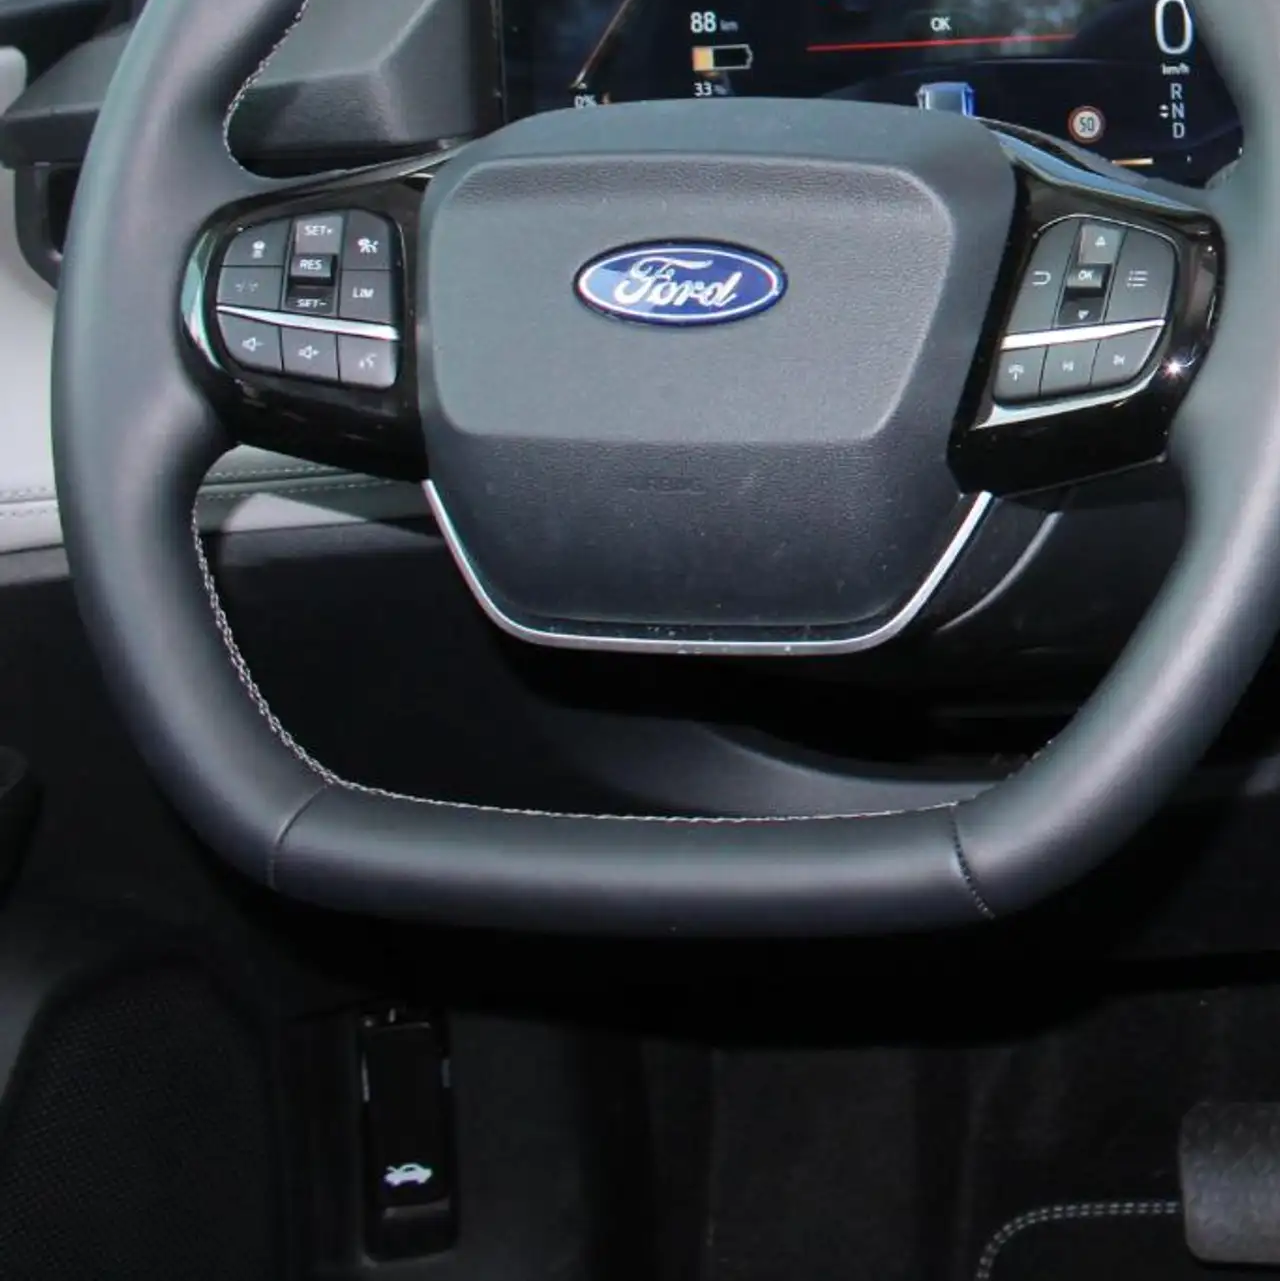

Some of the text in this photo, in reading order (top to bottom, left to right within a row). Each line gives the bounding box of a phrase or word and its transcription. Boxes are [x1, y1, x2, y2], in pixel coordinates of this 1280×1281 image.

[690, 12, 717, 32] 88
[930, 16, 952, 32] OK
[694, 82, 712, 96] 33
[1171, 83, 1183, 100] R
[1171, 102, 1185, 119] N
[1079, 117, 1095, 132] 50
[1172, 122, 1185, 138] D
[300, 258, 323, 271] RES
[613, 256, 744, 307] Ford
[1078, 270, 1094, 281] OK
